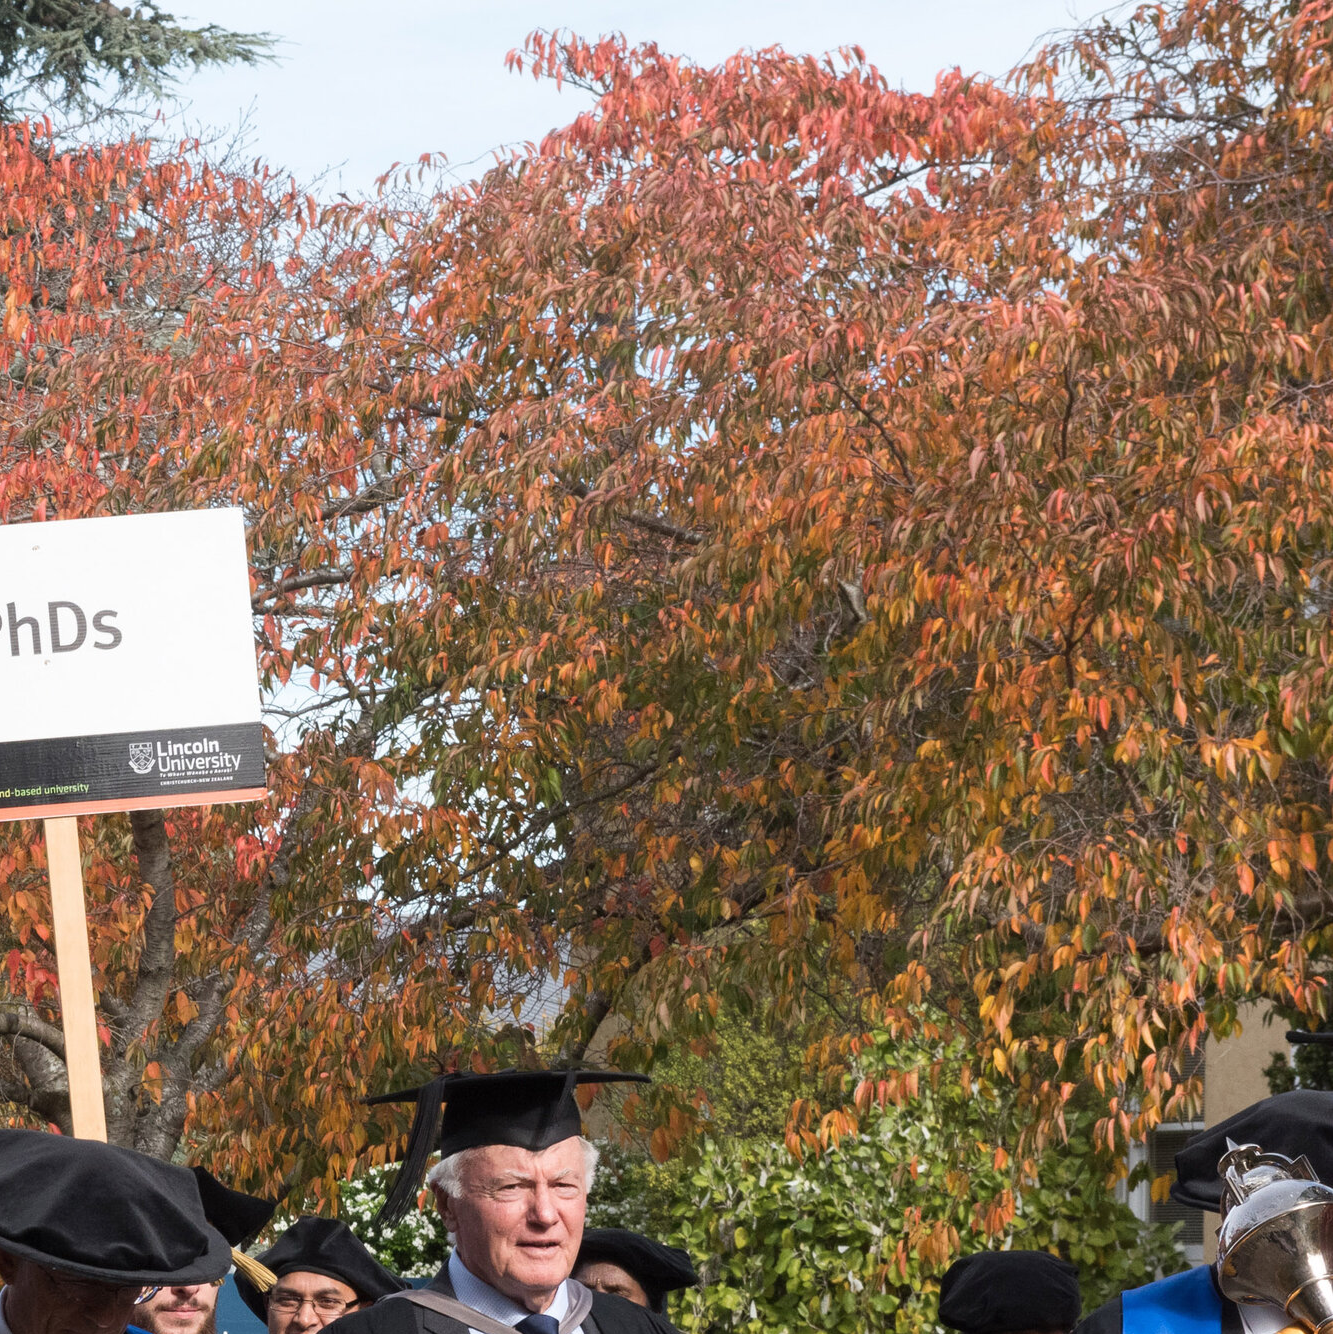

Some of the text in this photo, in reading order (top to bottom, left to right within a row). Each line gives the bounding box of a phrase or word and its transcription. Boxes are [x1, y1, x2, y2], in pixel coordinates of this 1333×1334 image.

[157, 738, 219, 757] Lincoln
[158, 752, 241, 772] University
[44, 783, 90, 795] university
